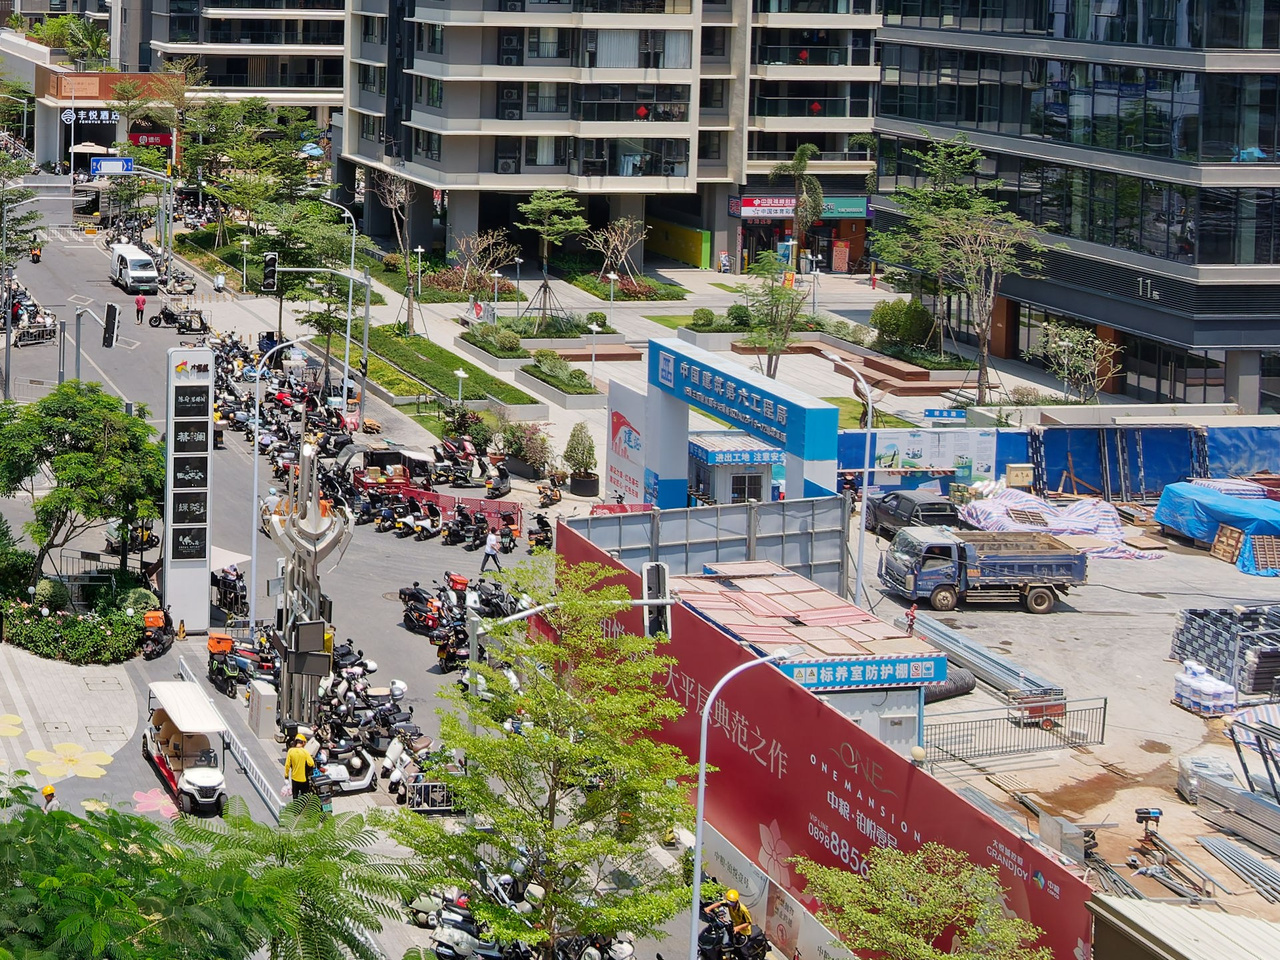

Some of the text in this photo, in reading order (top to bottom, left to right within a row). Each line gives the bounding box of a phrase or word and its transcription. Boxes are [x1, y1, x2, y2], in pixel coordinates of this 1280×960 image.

[77, 110, 120, 120] 丰悦酒店
[679, 361, 788, 427] 中国建筑第六工程局
[715, 452, 787, 463] 进出工地 注意安全
[820, 663, 909, 683] 标养室防护棚
[664, 664, 788, 779] 大平层典范之作
[810, 754, 921, 844] ONE MANSION
[808, 822, 830, 849] 0898
[986, 845, 1029, 881] GRANDJOY
